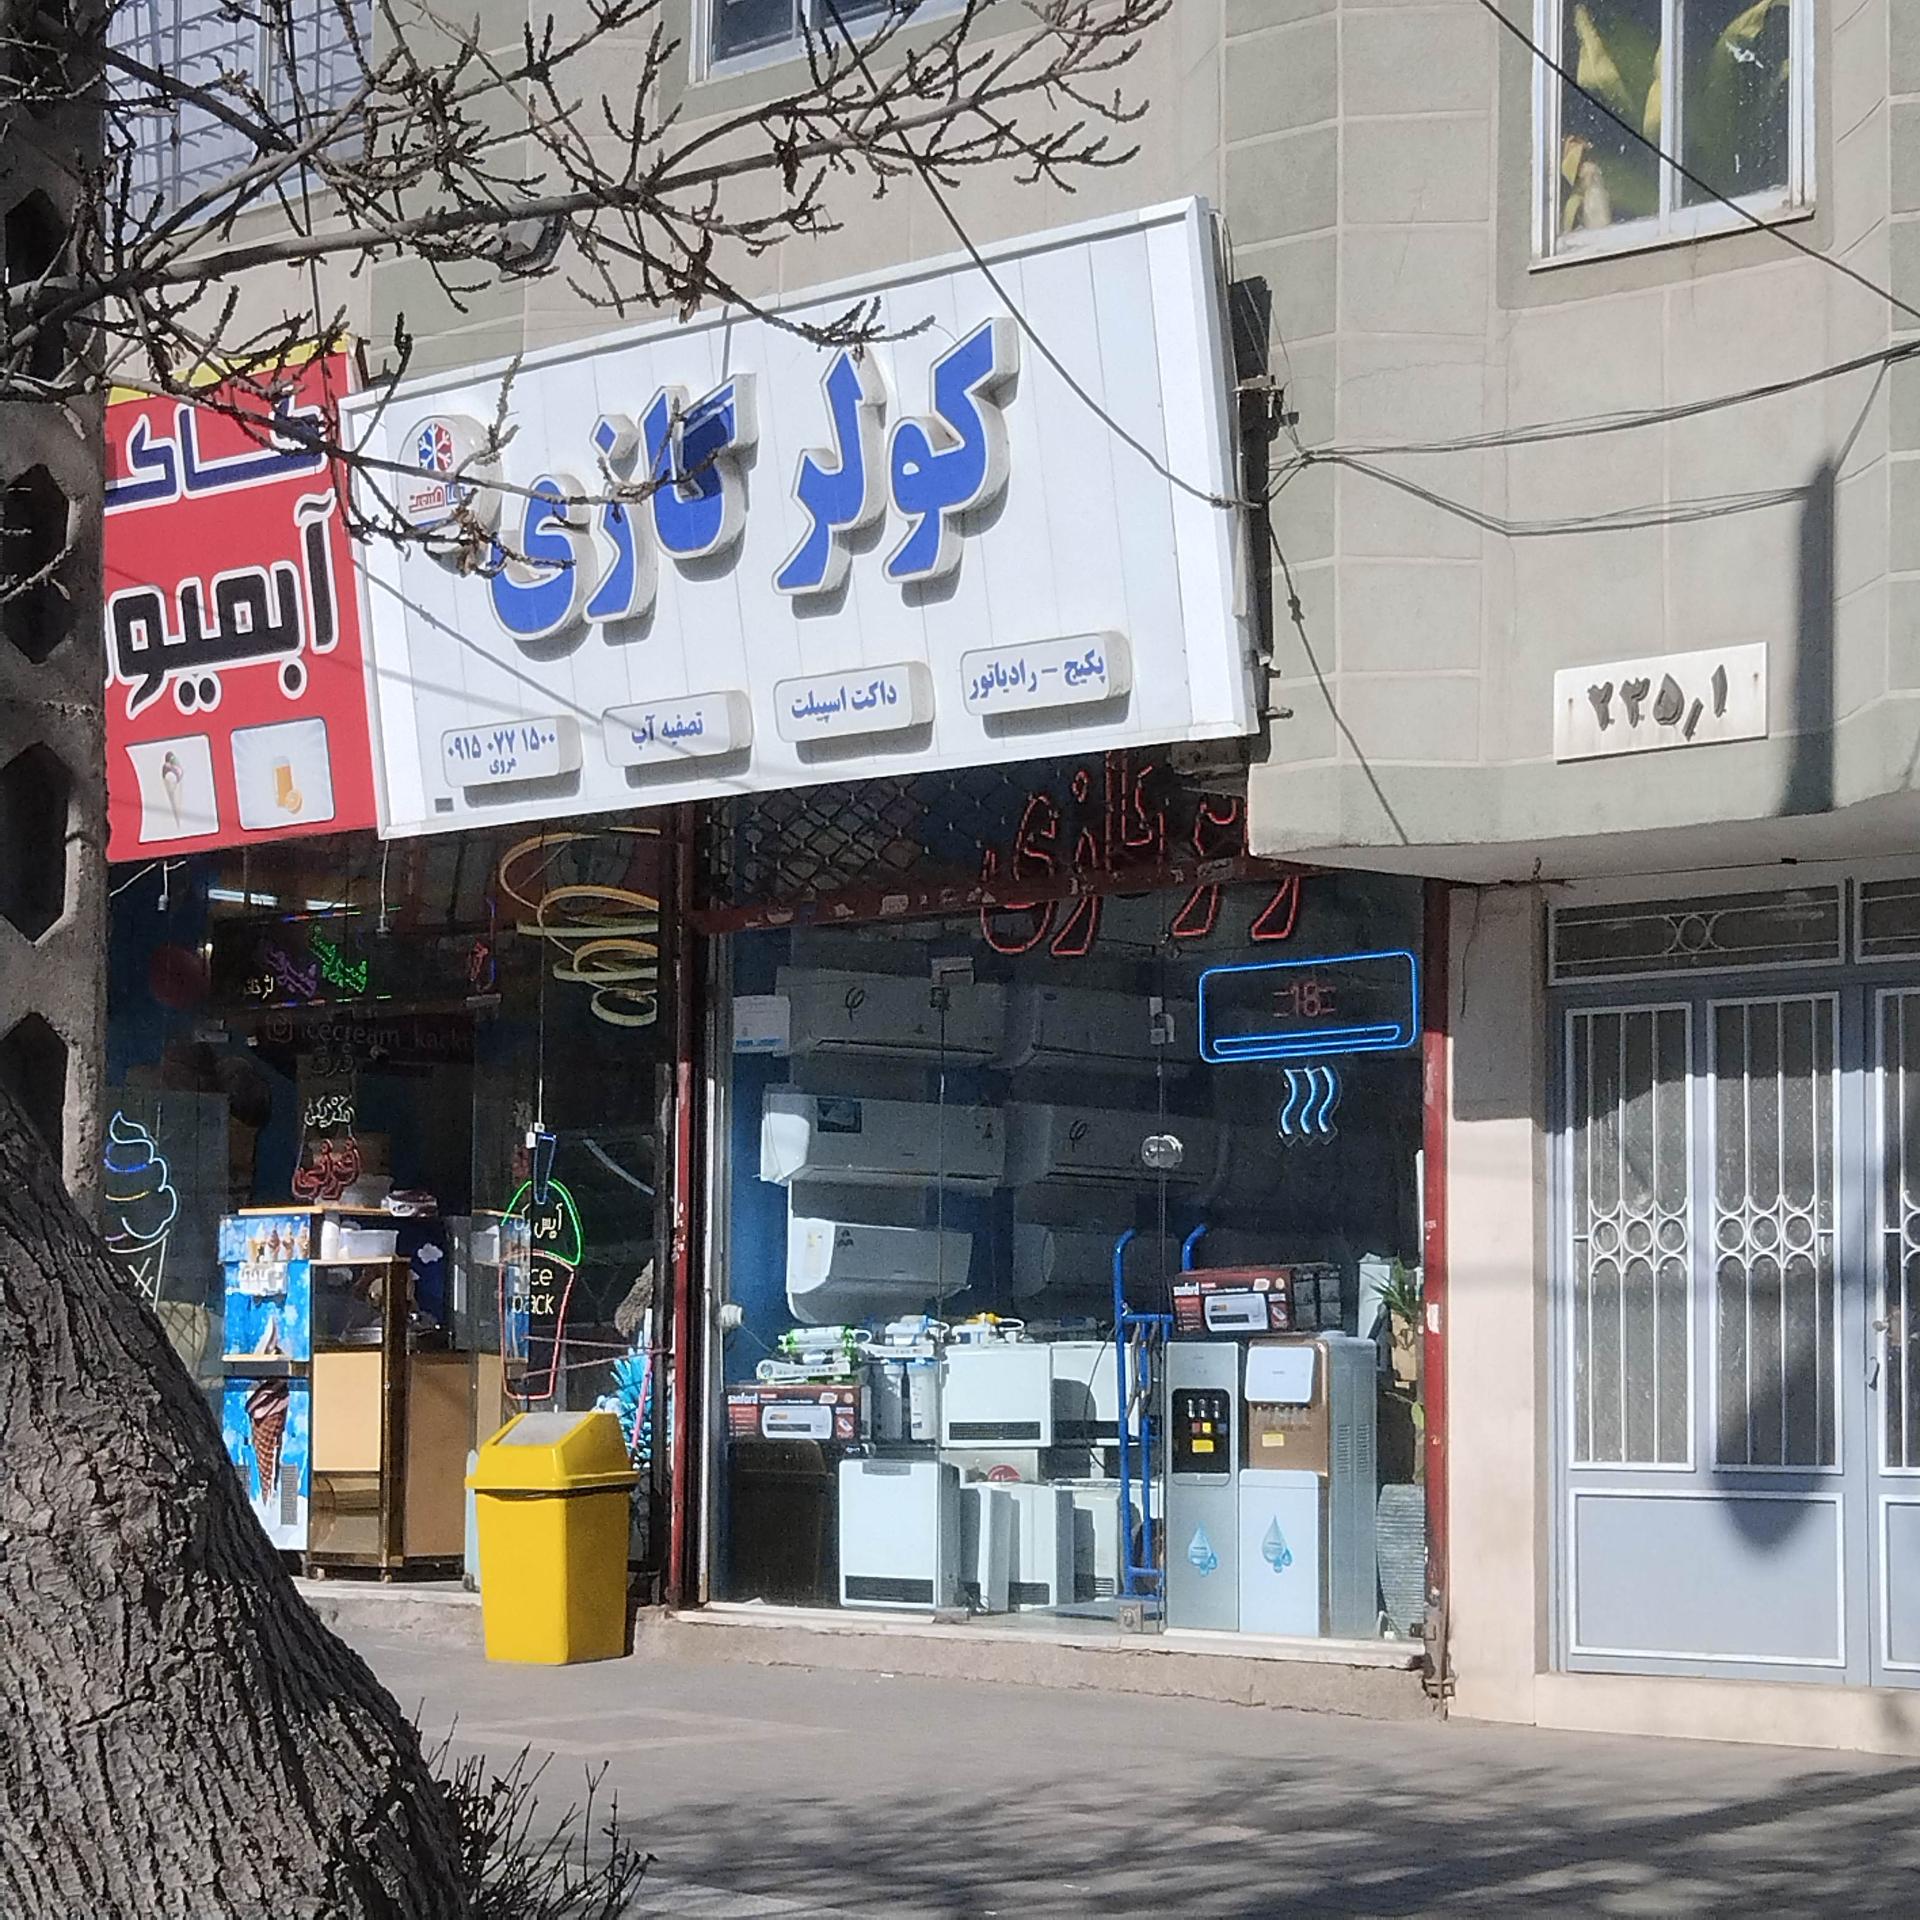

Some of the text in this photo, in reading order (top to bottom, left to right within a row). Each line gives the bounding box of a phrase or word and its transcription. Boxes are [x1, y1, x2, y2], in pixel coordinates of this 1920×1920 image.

[489, 318, 1004, 639] کولر گازی
[105, 488, 339, 721] آبمیو
[969, 658, 1037, 700] رادیاتور
[1064, 649, 1106, 686] پکیج
[791, 680, 897, 723] داکت اسپیلت
[447, 726, 556, 760] ۰۹۱۵ ۰۷۷ ۱۵۰۰
[631, 711, 704, 750] تصفیه آب
